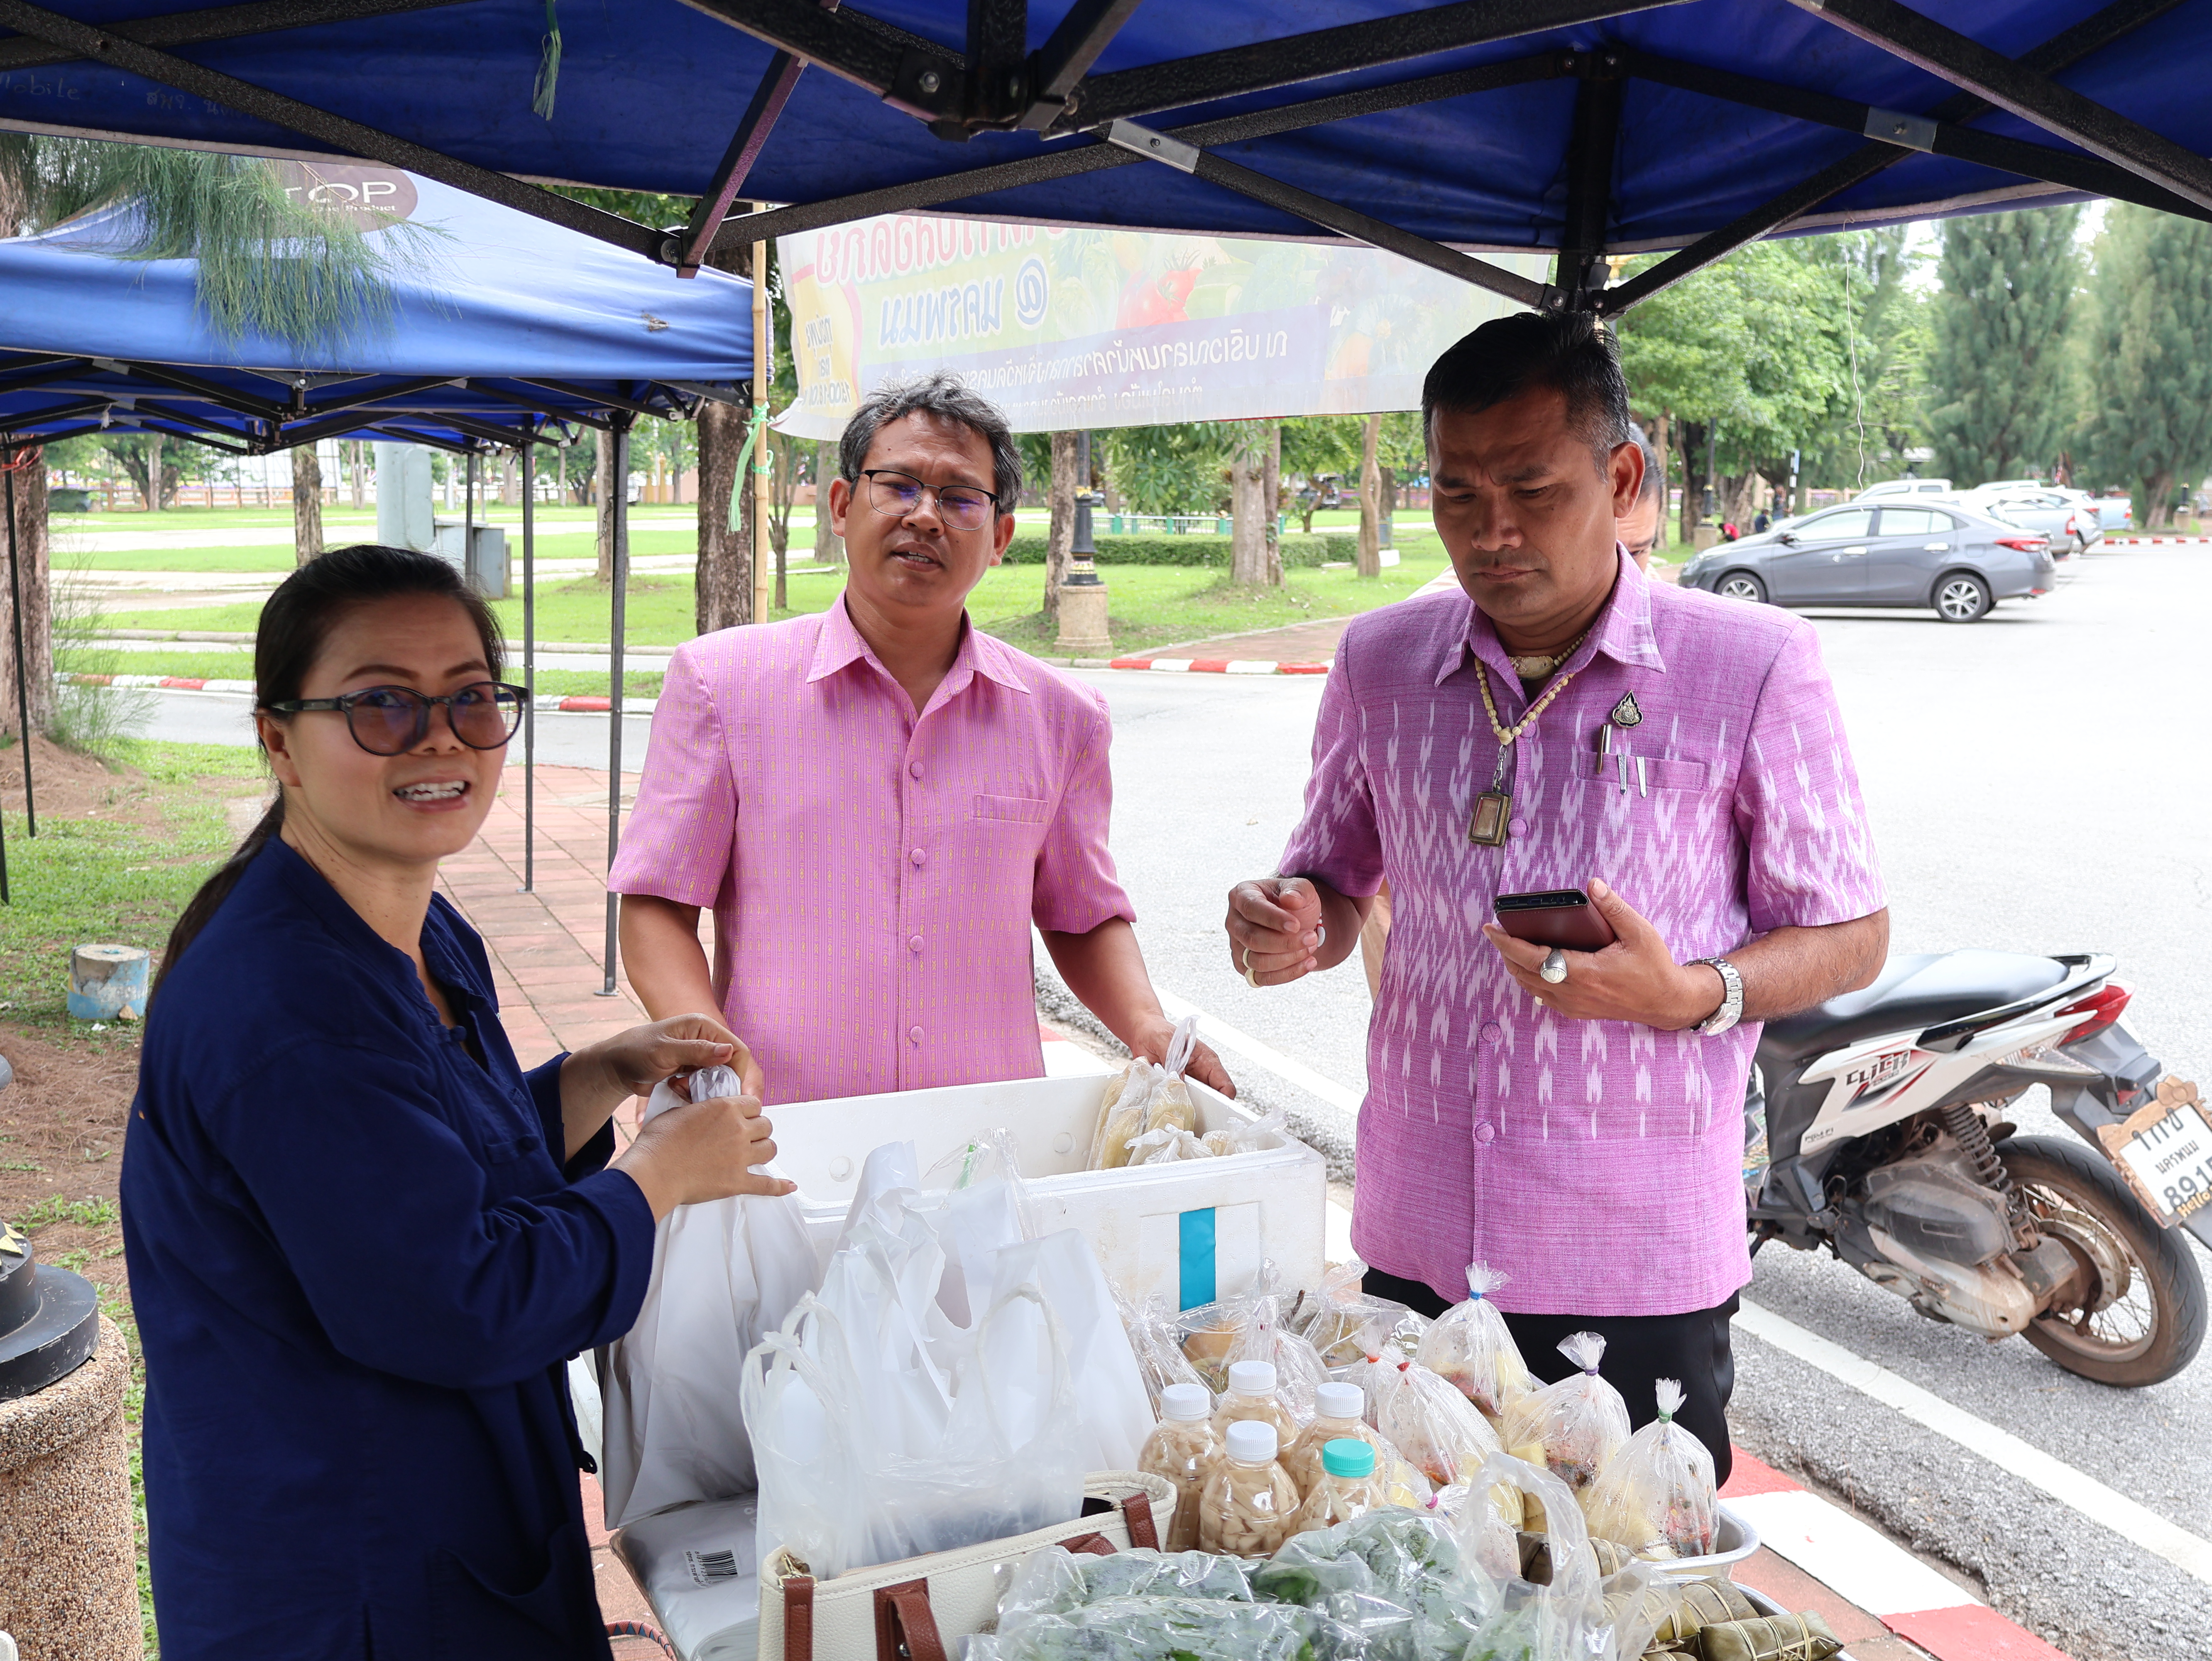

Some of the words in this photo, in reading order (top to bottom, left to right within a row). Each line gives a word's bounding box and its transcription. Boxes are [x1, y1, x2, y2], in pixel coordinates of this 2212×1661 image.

[2155, 1139, 2200, 1174] นครพนม
[2176, 1191, 2211, 1218] Hello
